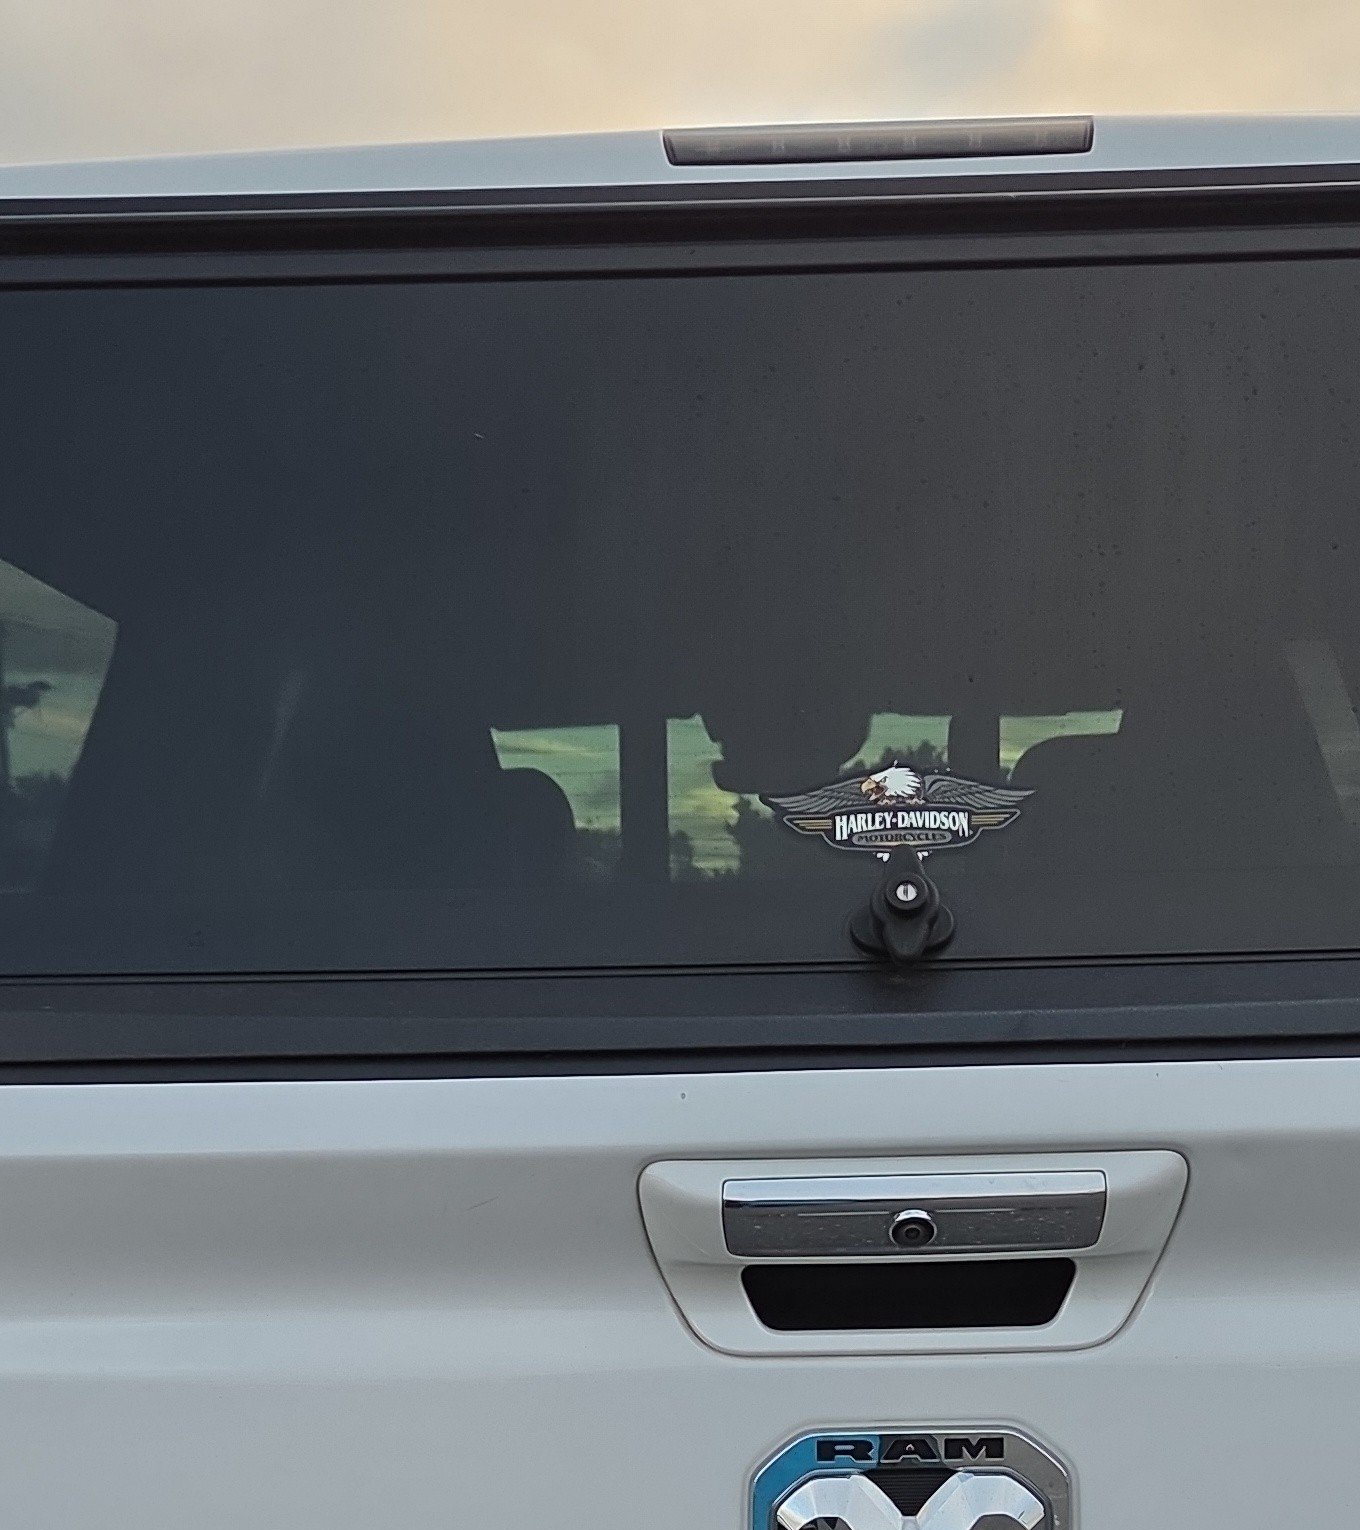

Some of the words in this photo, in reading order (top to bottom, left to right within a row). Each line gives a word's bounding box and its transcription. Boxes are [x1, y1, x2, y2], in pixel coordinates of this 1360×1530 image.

[834, 811, 969, 841] HARLEY-DAVIDSON
[856, 831, 947, 844] MOTORCYCLES
[815, 1437, 1006, 1463] RAM
